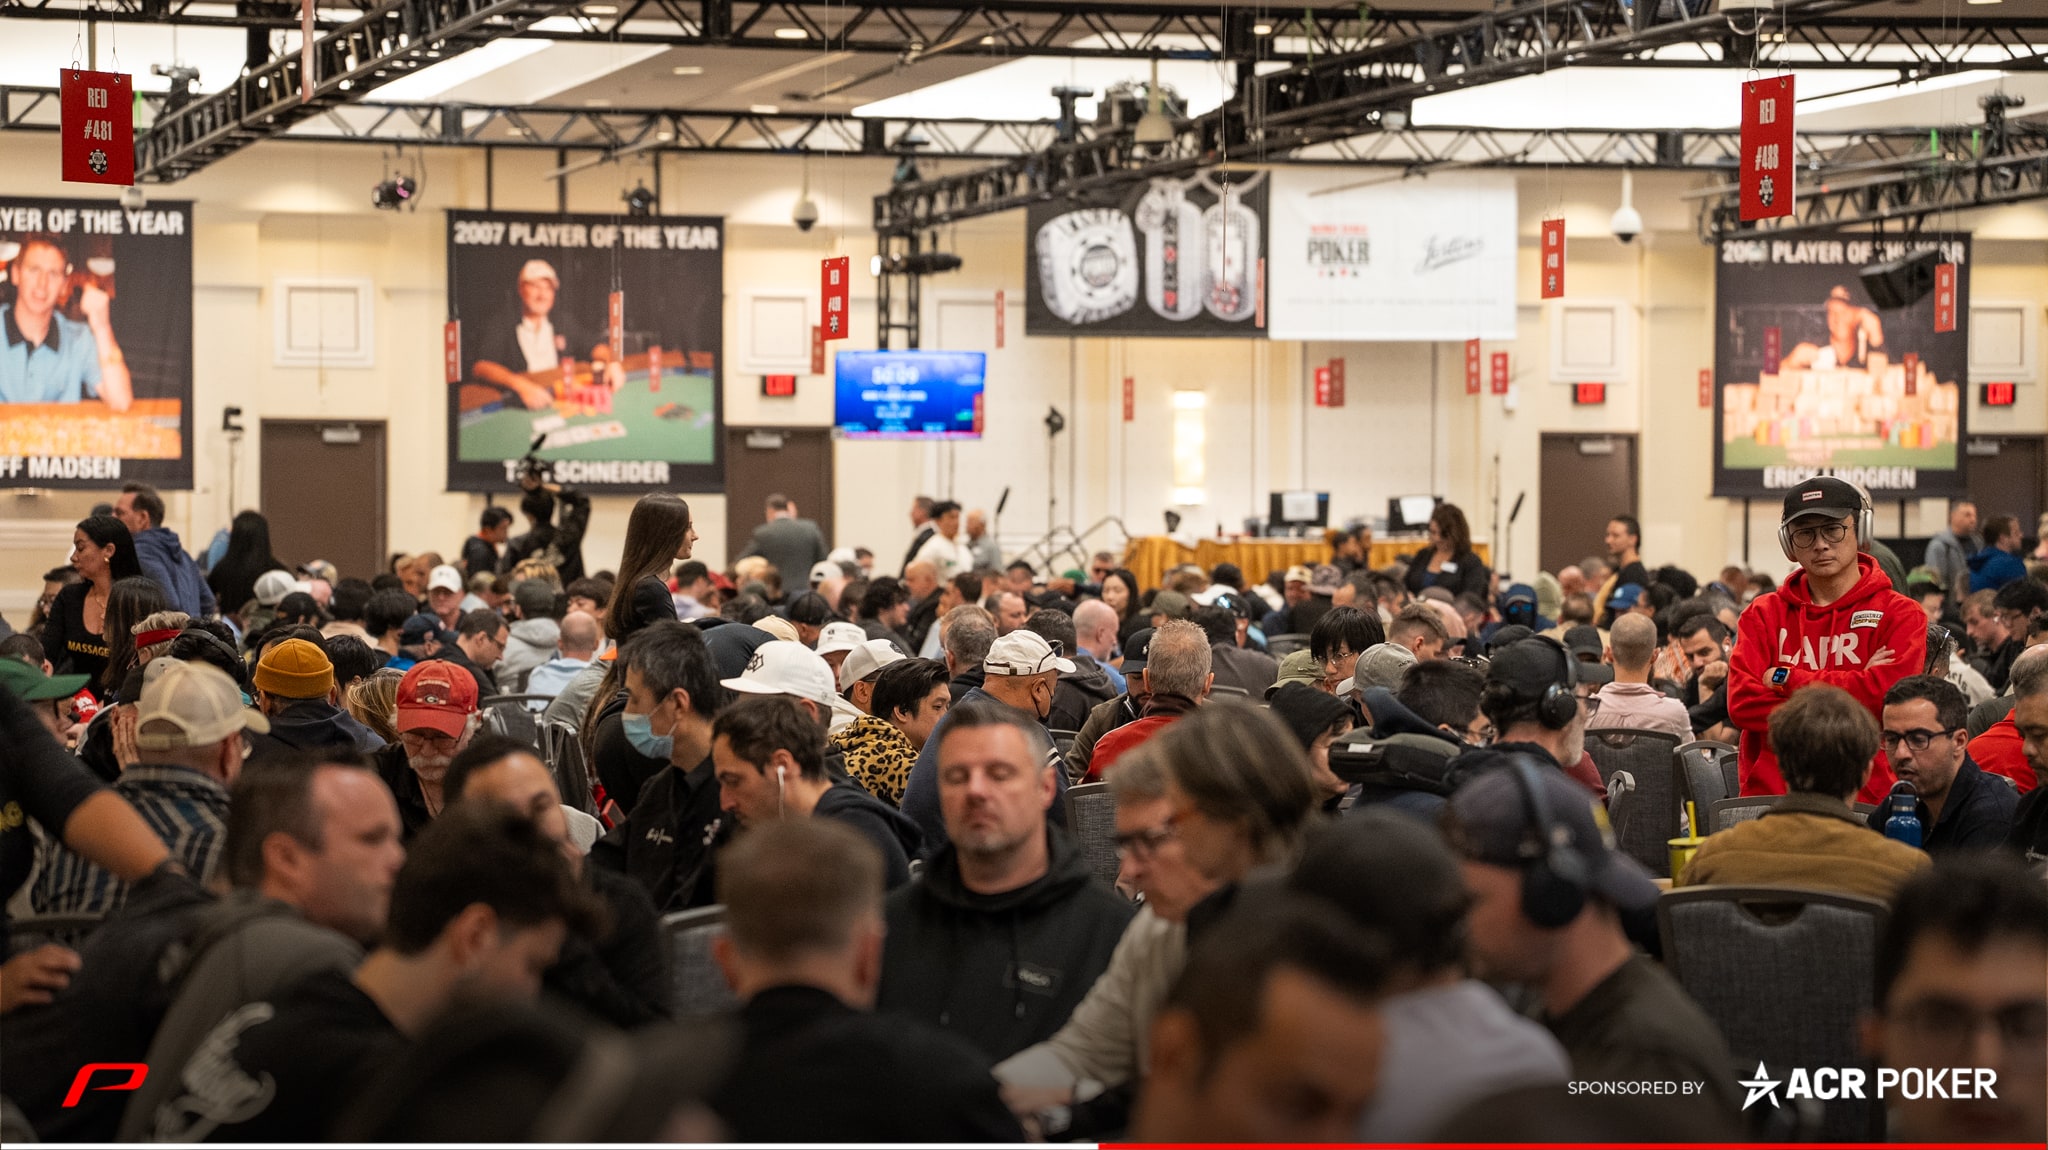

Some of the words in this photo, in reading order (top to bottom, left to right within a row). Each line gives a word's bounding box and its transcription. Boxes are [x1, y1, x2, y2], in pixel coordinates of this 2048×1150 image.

[87, 87, 108, 109] RED
[1759, 98, 1776, 125] RED
[83, 119, 113, 141] #481
[47, 208, 77, 233] OF
[80, 209, 123, 234] THE
[126, 210, 184, 235] YEAR
[453, 220, 506, 245] 2007
[508, 222, 588, 247] PLAYER
[590, 224, 617, 248] OF
[621, 225, 662, 249] THE
[663, 225, 719, 249] YEAR
[1772, 240, 1844, 264] PLAYER
[1846, 240, 1874, 264] OF
[28, 456, 121, 480] MADSEN
[553, 459, 670, 484] SCHNEIDER
[67, 640, 111, 658] MASSAGE
[1778, 627, 1862, 671] LAPR
